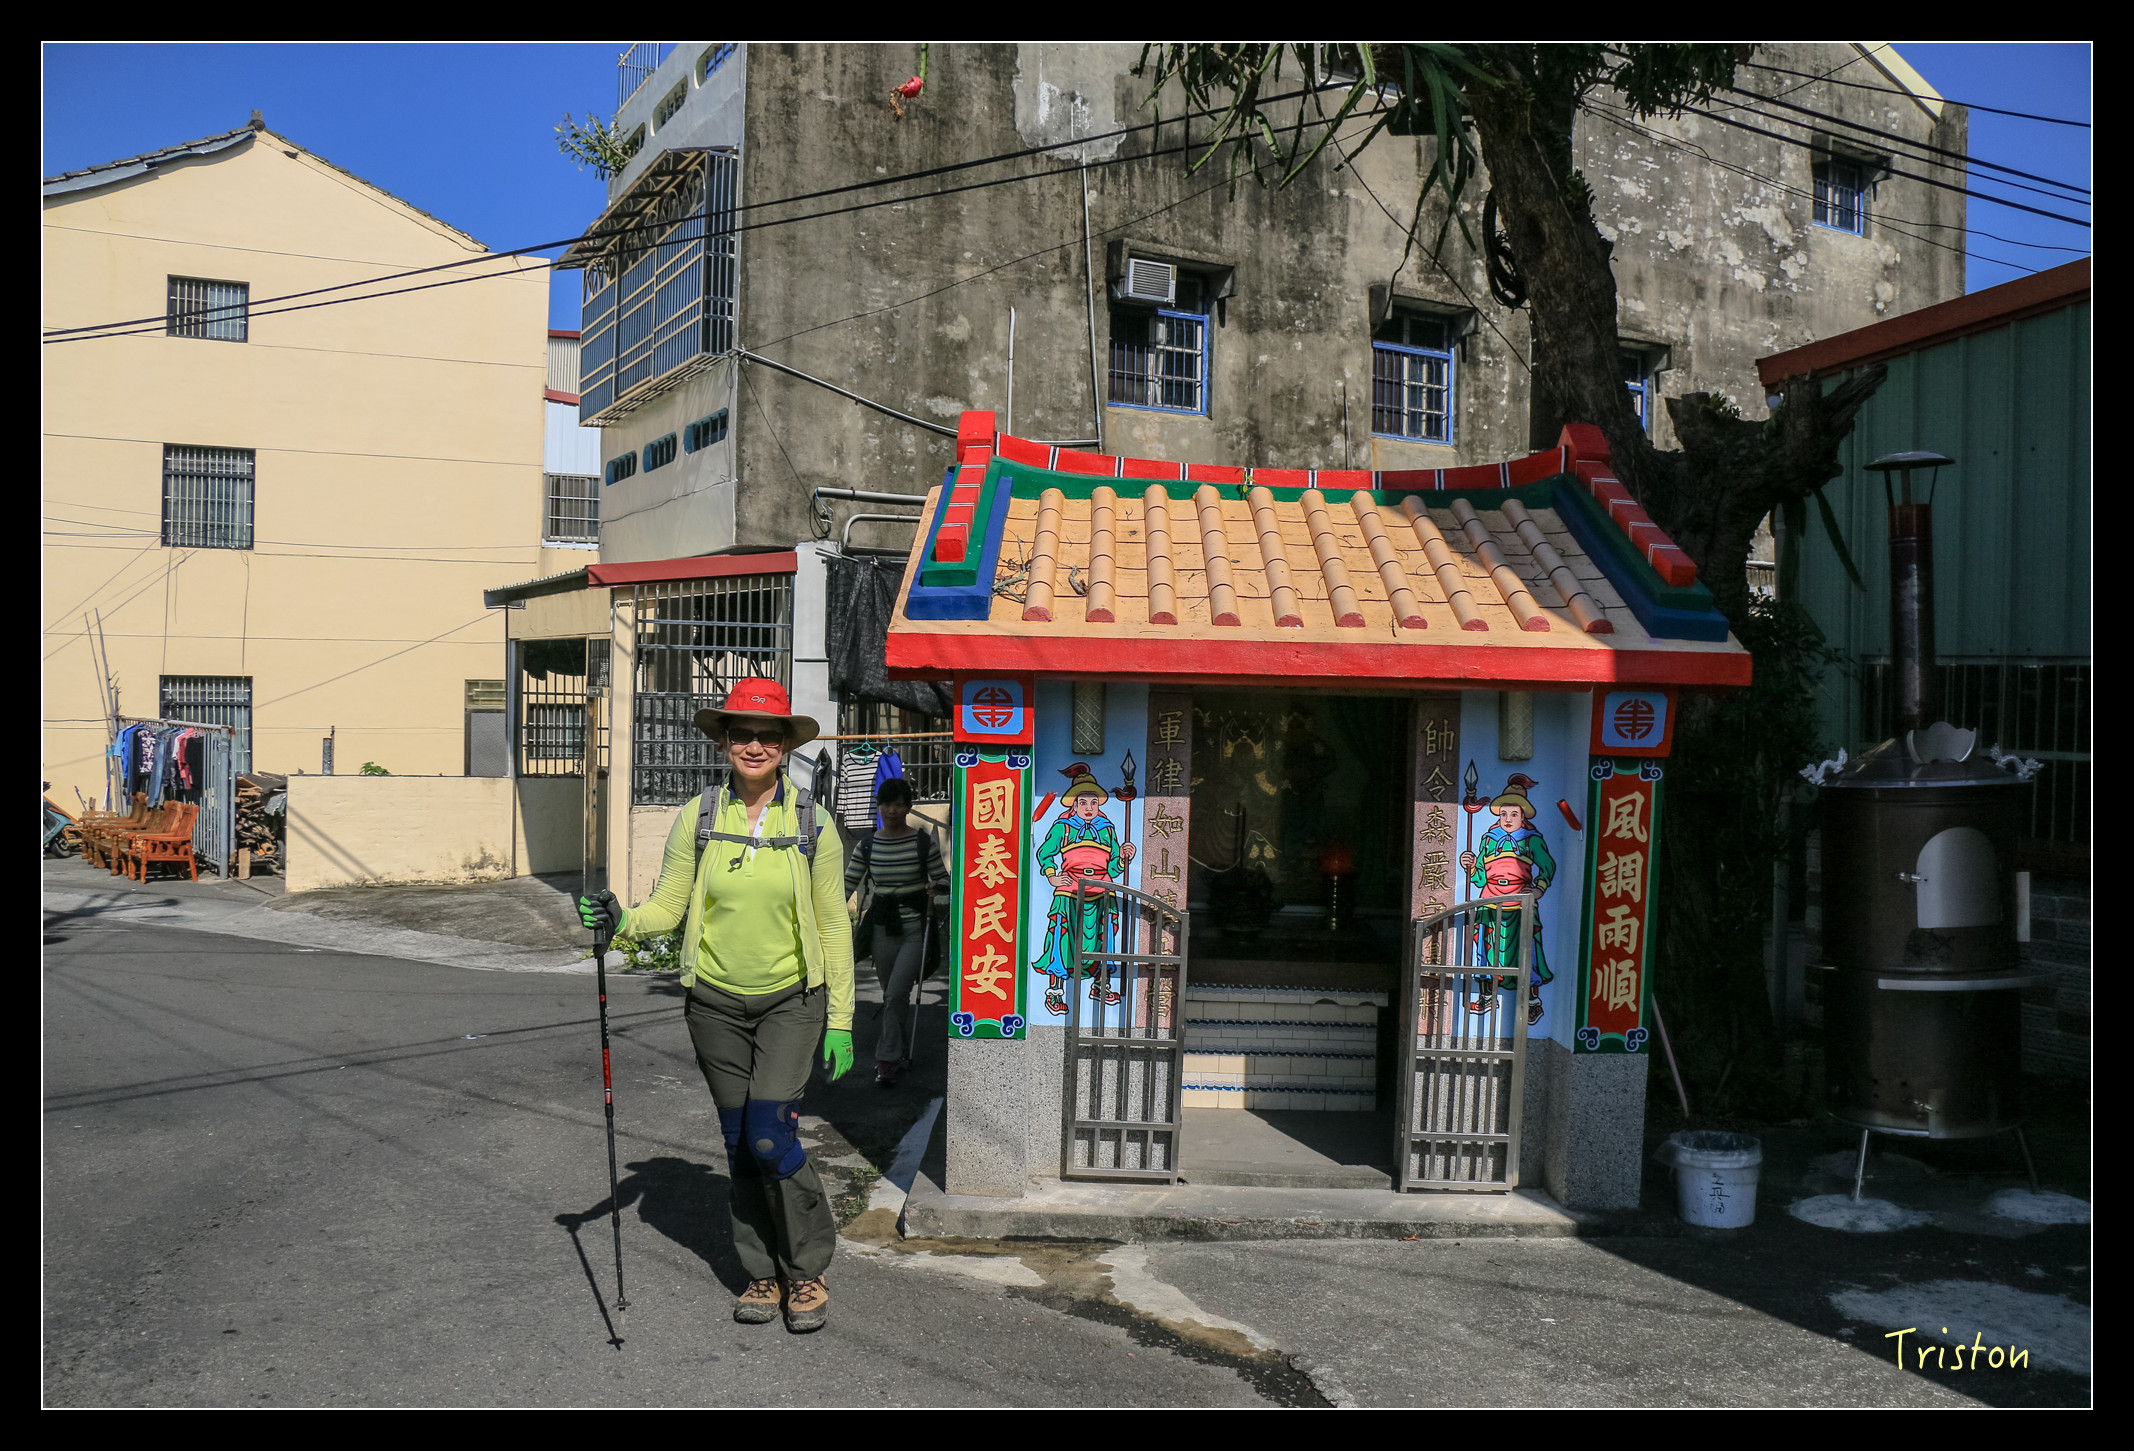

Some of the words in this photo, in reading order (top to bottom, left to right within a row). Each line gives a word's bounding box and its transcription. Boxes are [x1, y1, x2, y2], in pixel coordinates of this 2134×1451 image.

[750, 695, 767, 705] OR
[963, 778, 1017, 1001] 國泰民安
[1593, 791, 1647, 1013] 風調雨順
